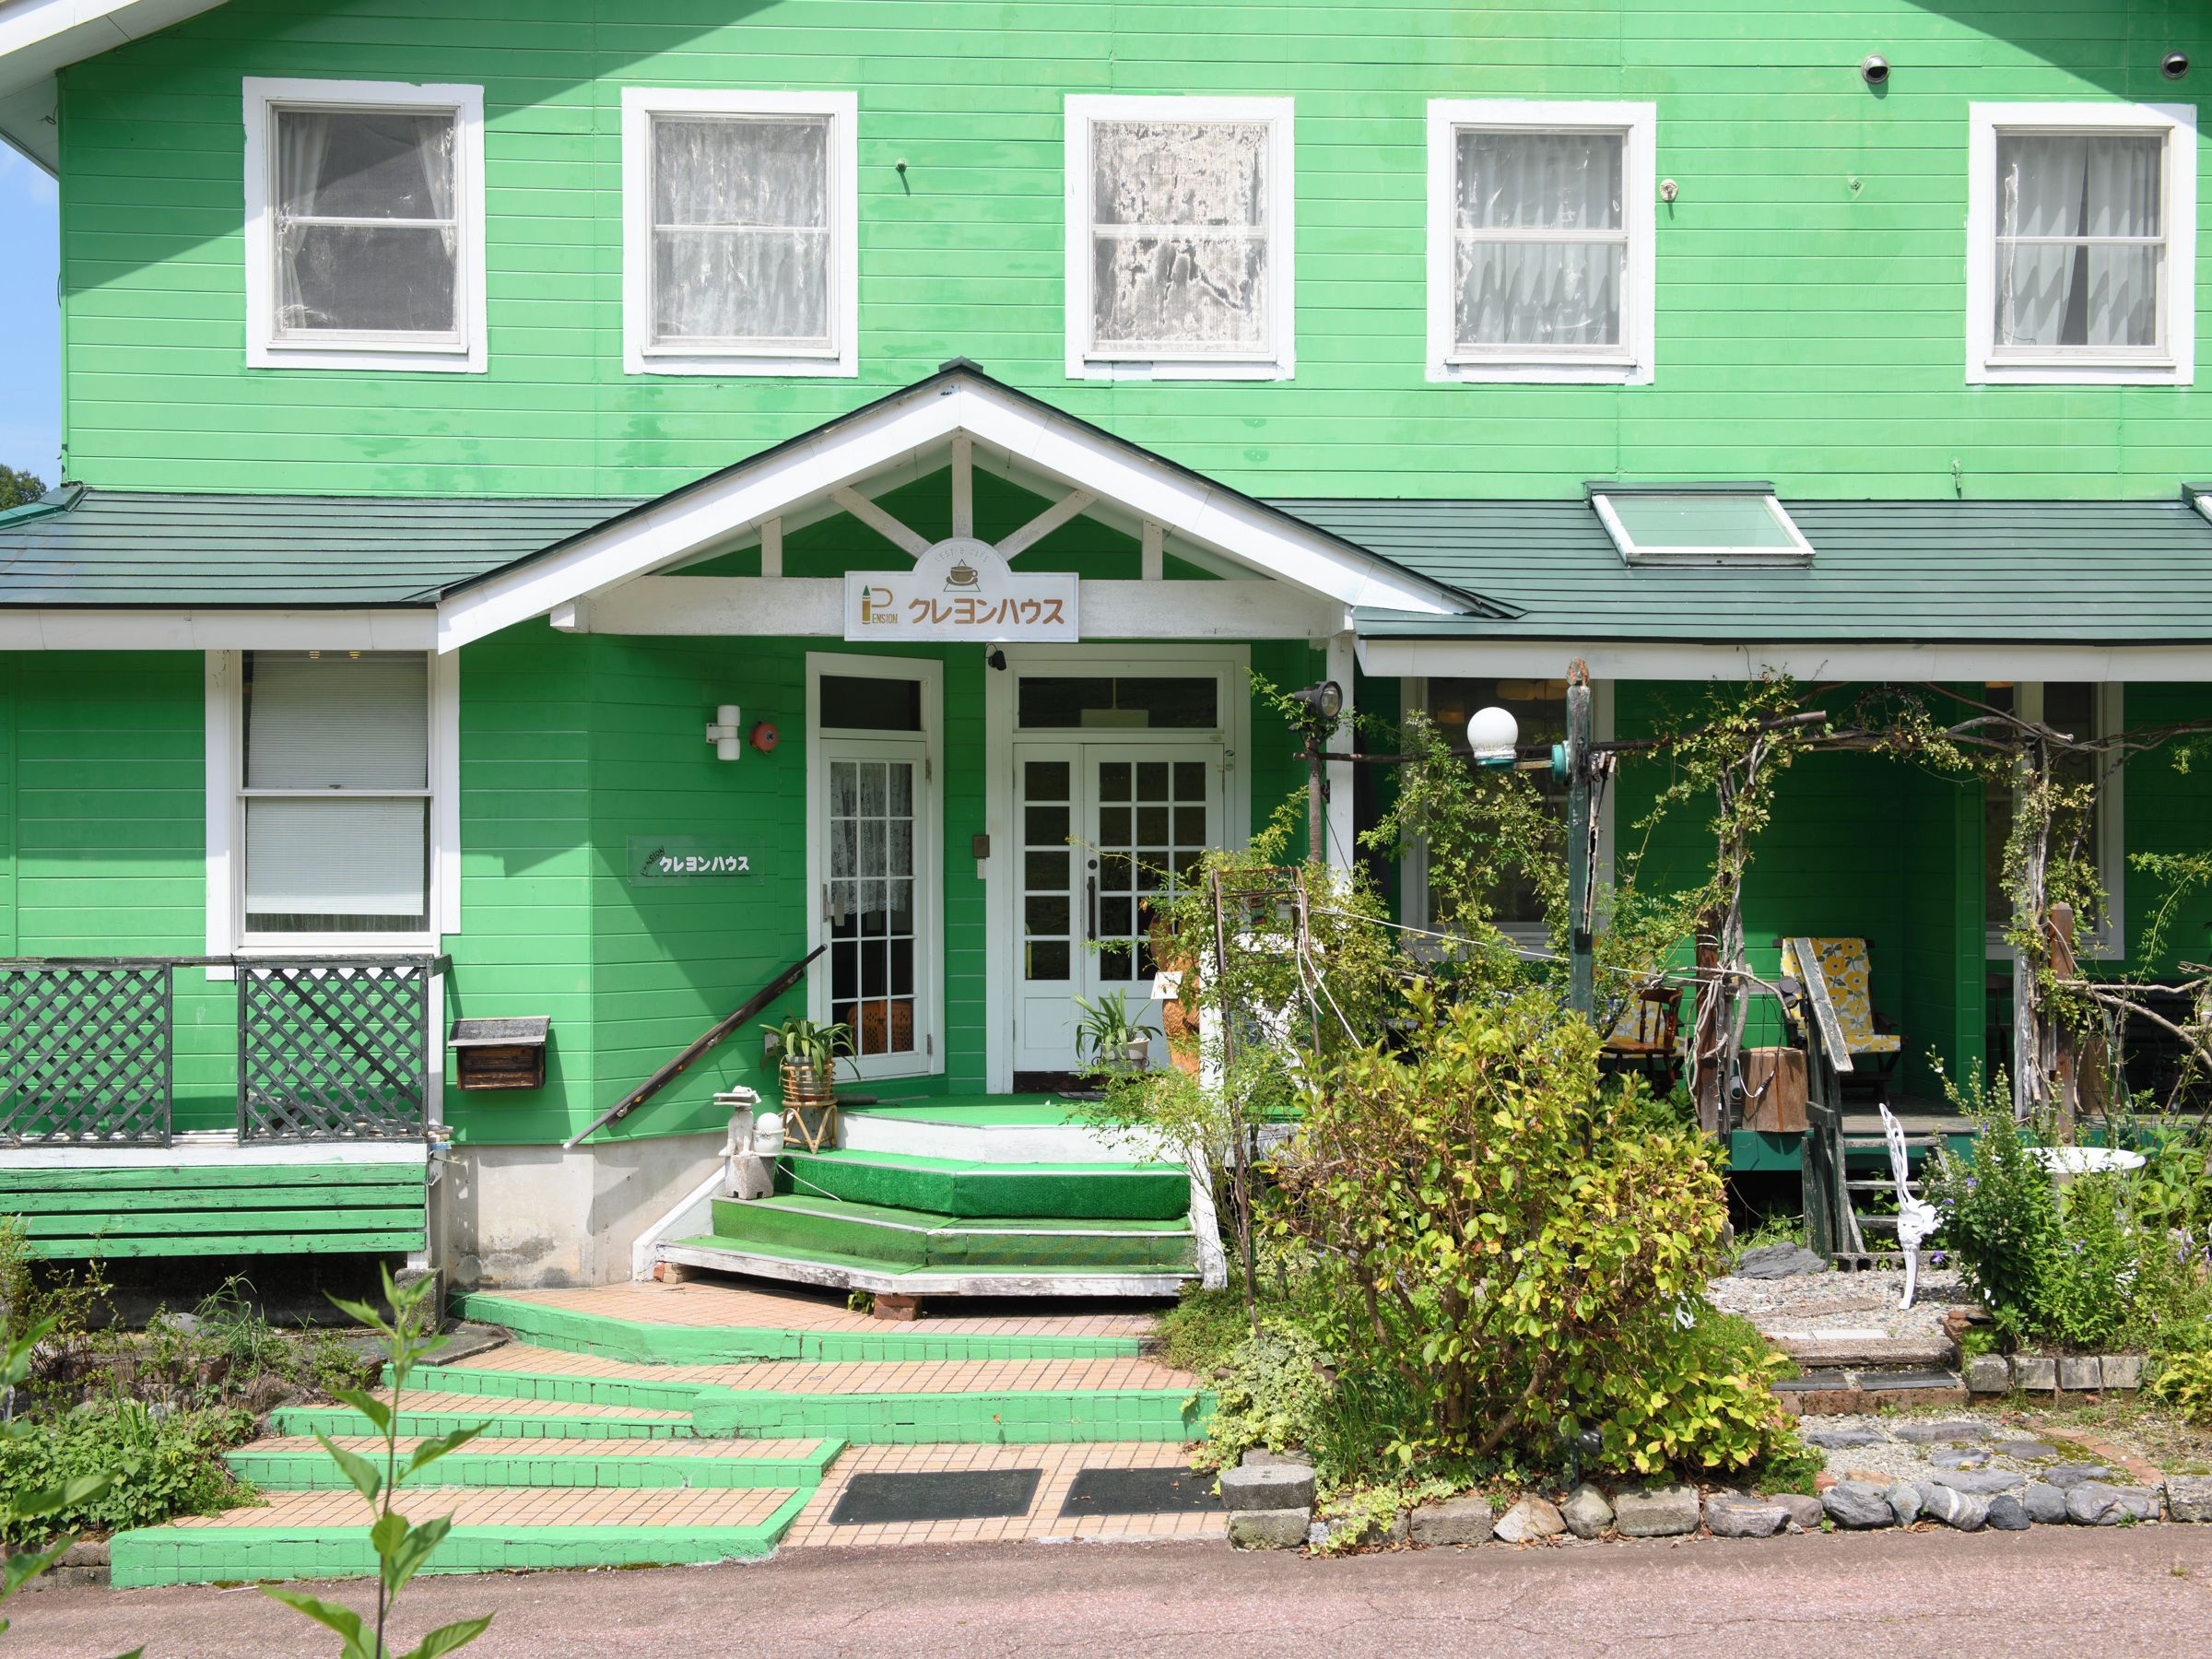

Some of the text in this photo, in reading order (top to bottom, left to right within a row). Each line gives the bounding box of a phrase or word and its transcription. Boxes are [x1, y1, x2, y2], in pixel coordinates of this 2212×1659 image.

[908, 598, 1065, 624] クレヨンハウス
[640, 845, 665, 876] NSION
[659, 856, 750, 873] クレヨンハウス
